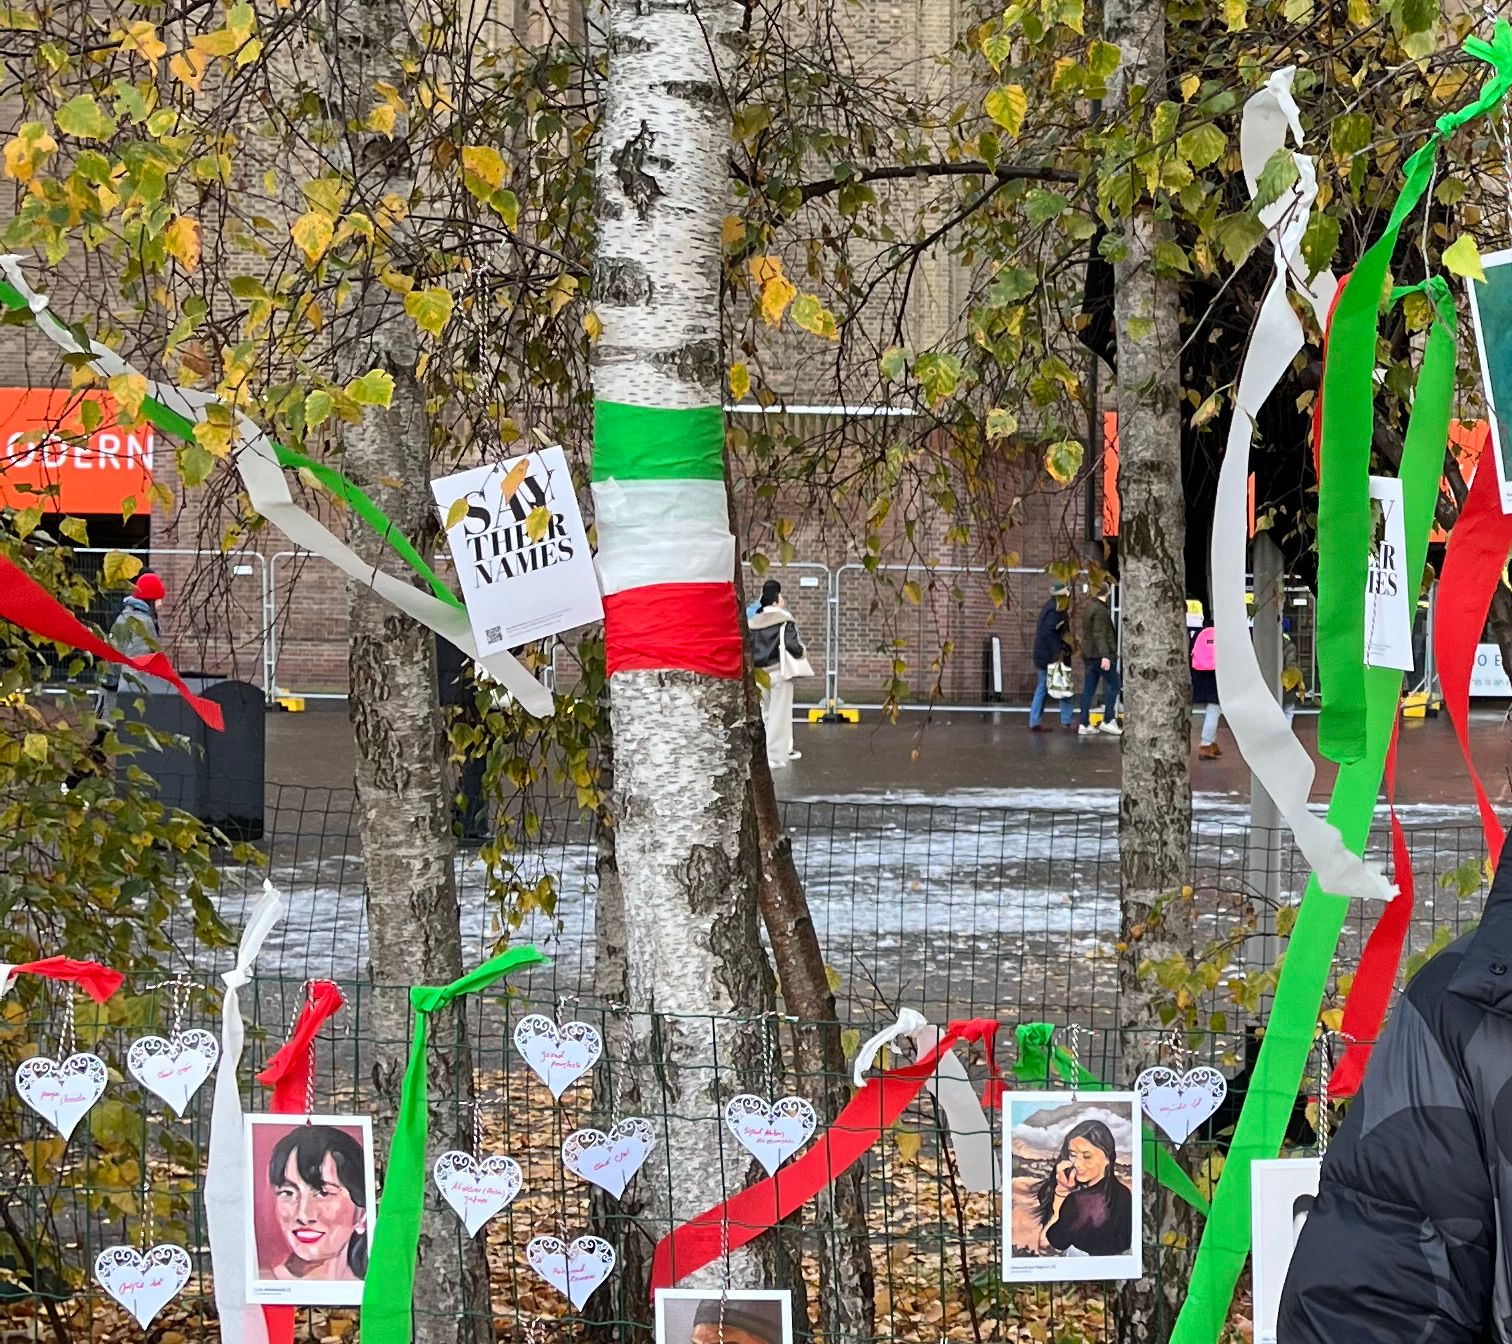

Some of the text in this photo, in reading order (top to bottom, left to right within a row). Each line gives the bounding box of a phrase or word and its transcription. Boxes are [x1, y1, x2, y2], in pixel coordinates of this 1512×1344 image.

[6, 430, 154, 470] ODERN
[463, 469, 556, 538] SAY
[466, 513, 569, 562] THER
[473, 537, 575, 589] NAMES
